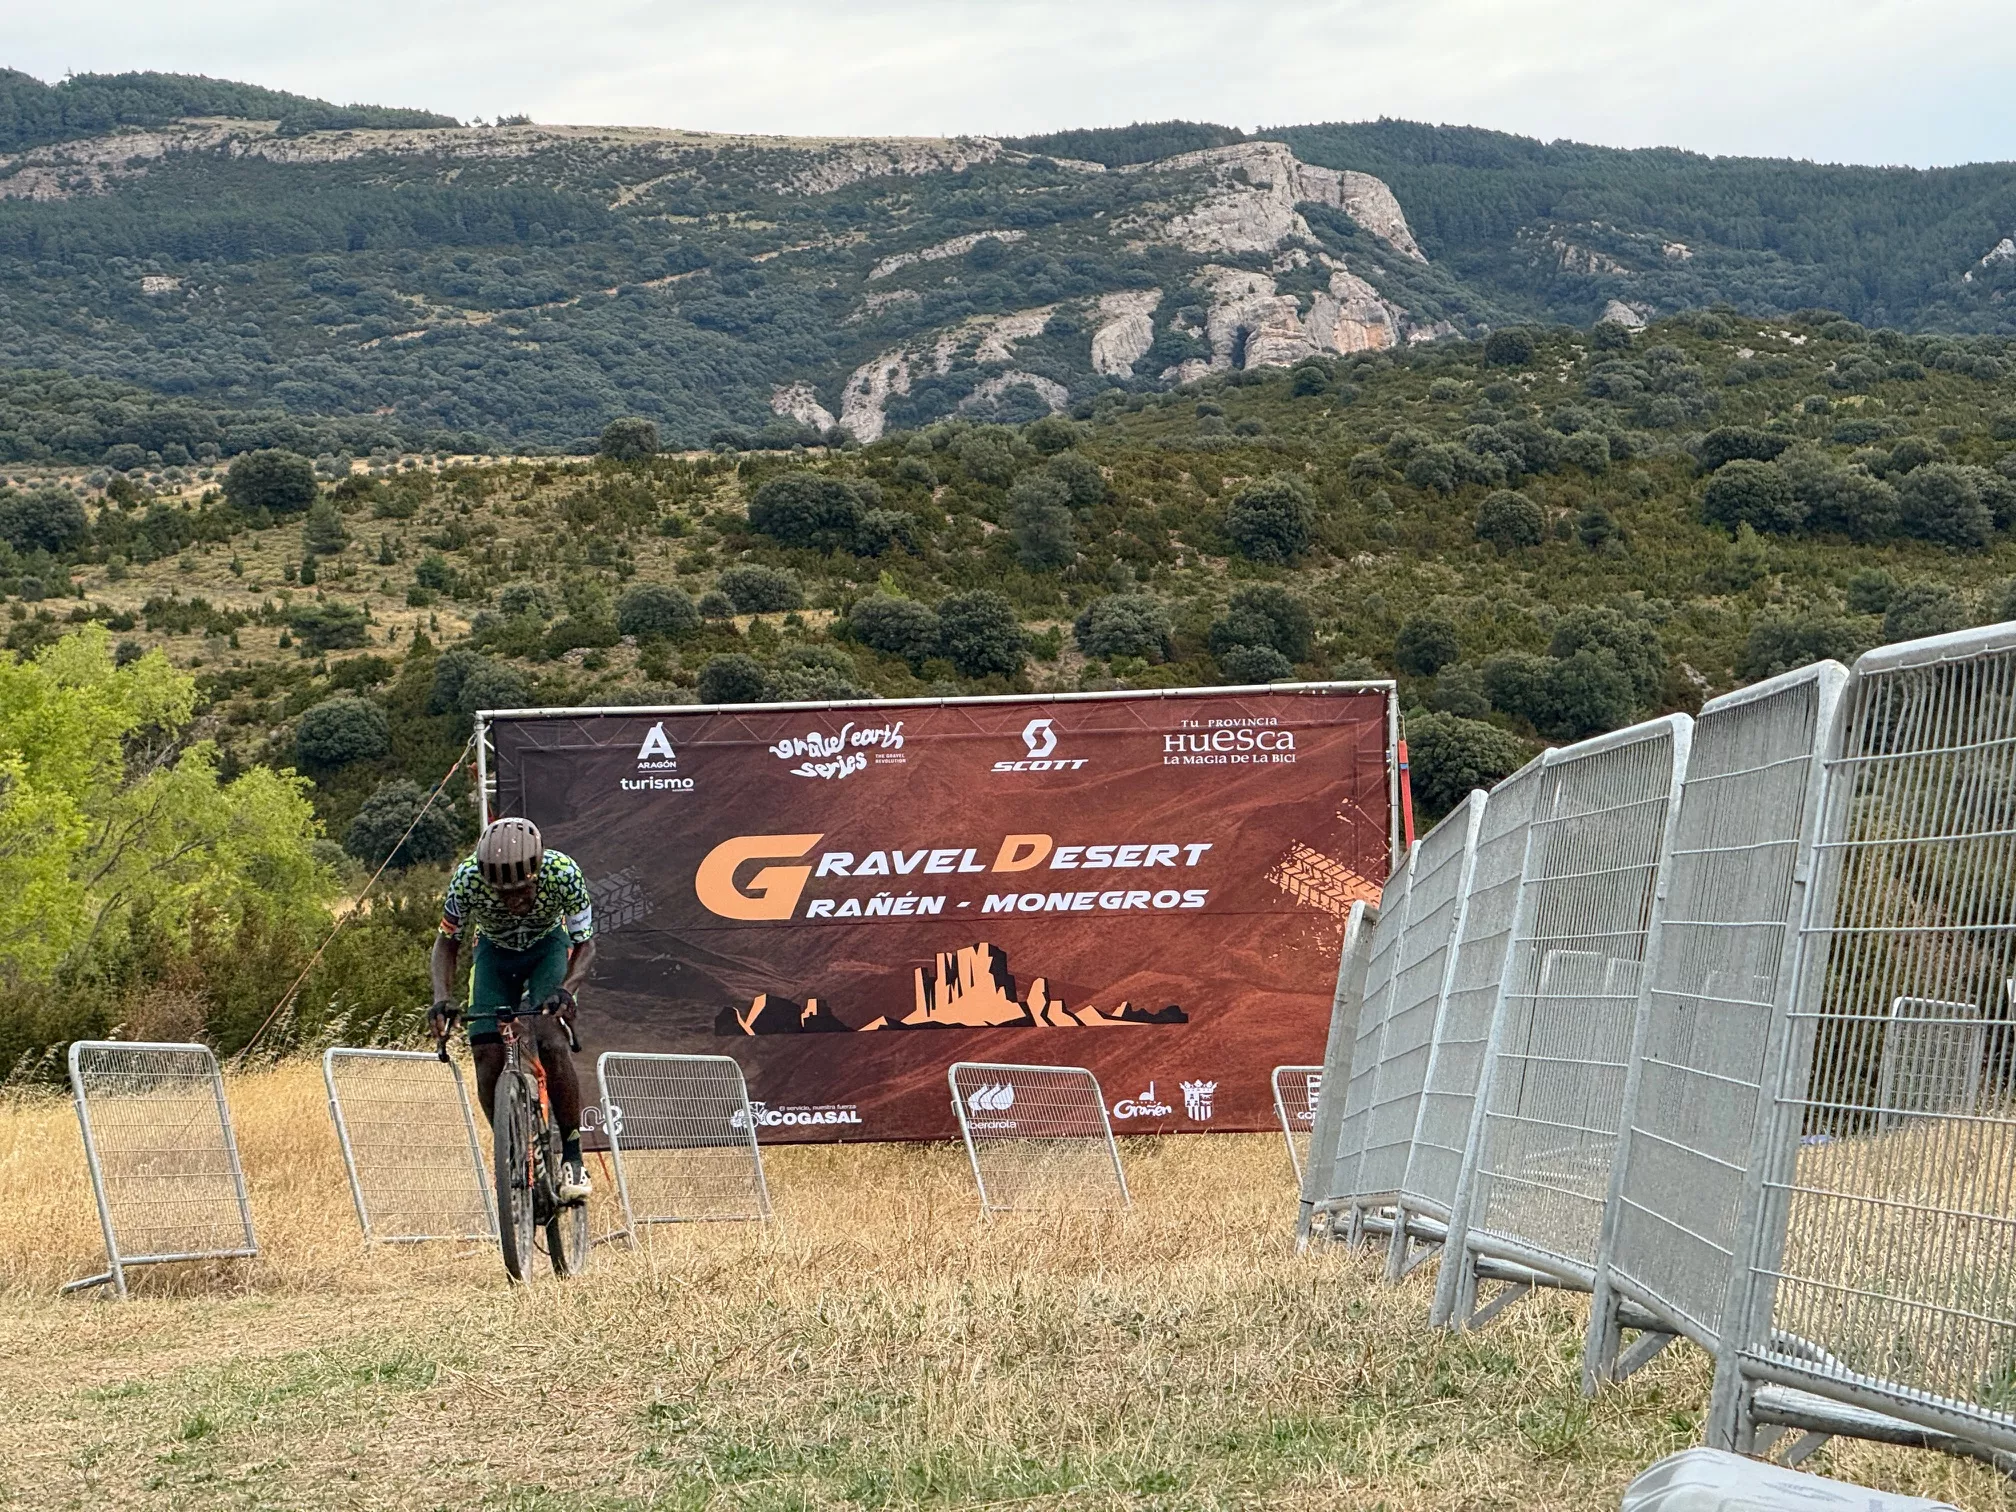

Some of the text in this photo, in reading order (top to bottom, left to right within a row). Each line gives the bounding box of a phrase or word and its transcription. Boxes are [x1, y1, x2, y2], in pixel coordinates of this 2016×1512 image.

[769, 721, 904, 759] gravel earth
[637, 760, 676, 769] ARAGÓN
[789, 752, 867, 779] series
[990, 759, 1089, 772] SCOTT
[620, 776, 694, 790] turismo
[991, 833, 1213, 873] DESERT
[981, 889, 1210, 914] MONEGROS
[502, 1024, 514, 1039] 4
[766, 1110, 862, 1126] COGASAL
[1113, 1099, 1172, 1119] Grañén
